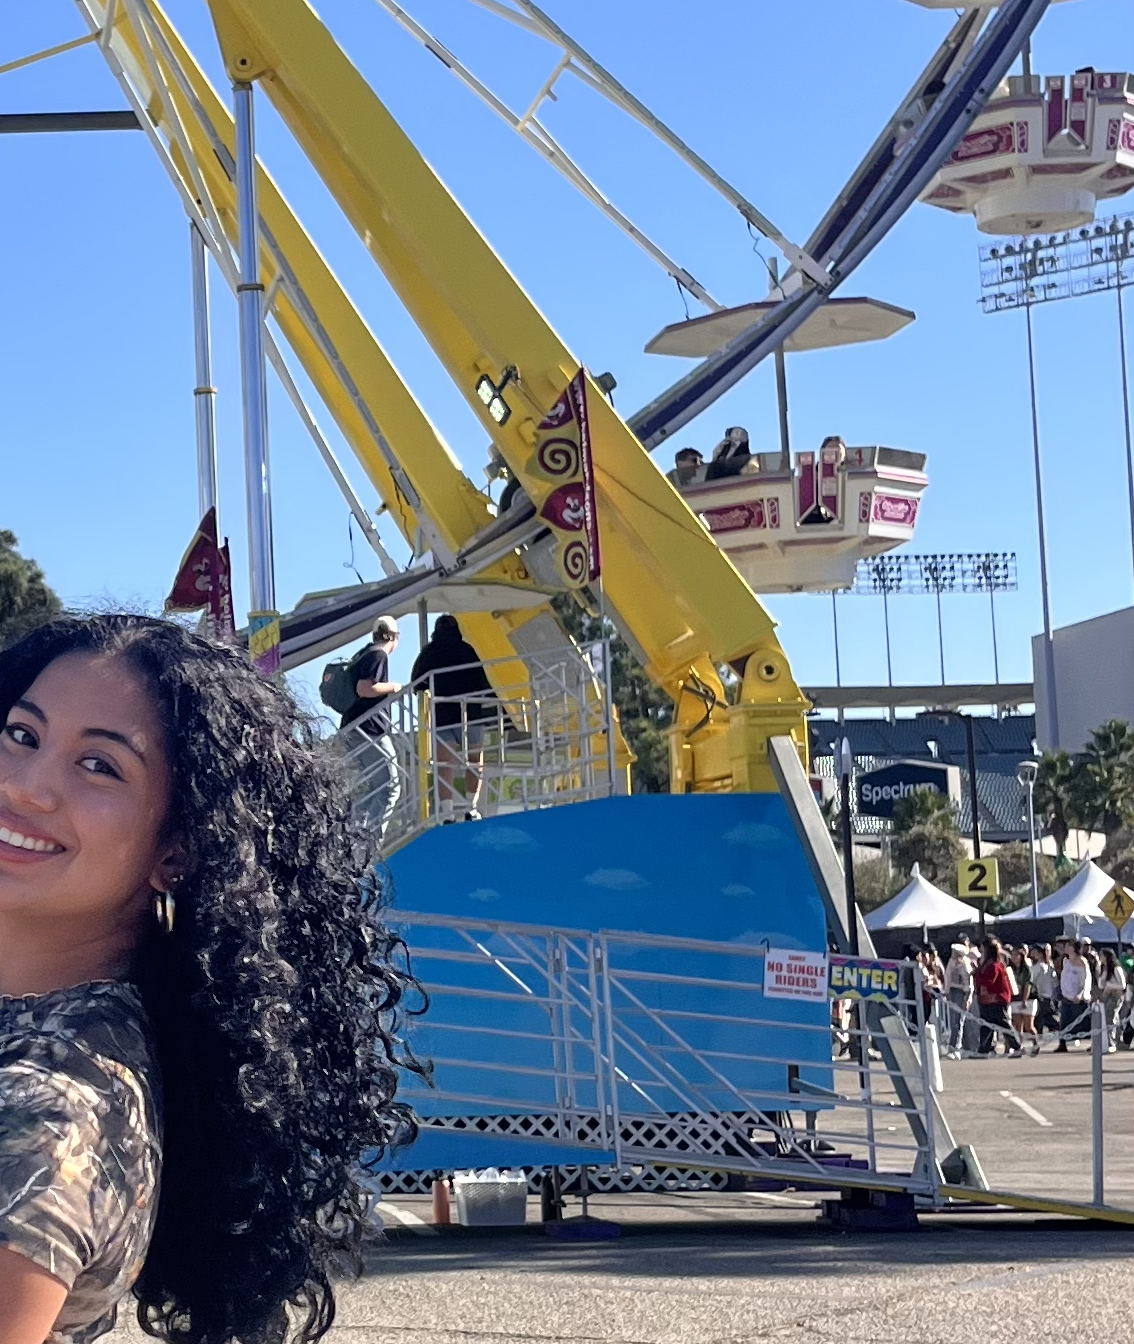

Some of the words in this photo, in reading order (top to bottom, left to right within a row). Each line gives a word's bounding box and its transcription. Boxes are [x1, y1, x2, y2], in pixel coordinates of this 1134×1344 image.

[967, 864, 987, 891] 2
[767, 961, 783, 973] NO
[786, 963, 826, 978] SINGLE
[831, 965, 898, 991] ENTER
[775, 974, 817, 989] RIDERS
